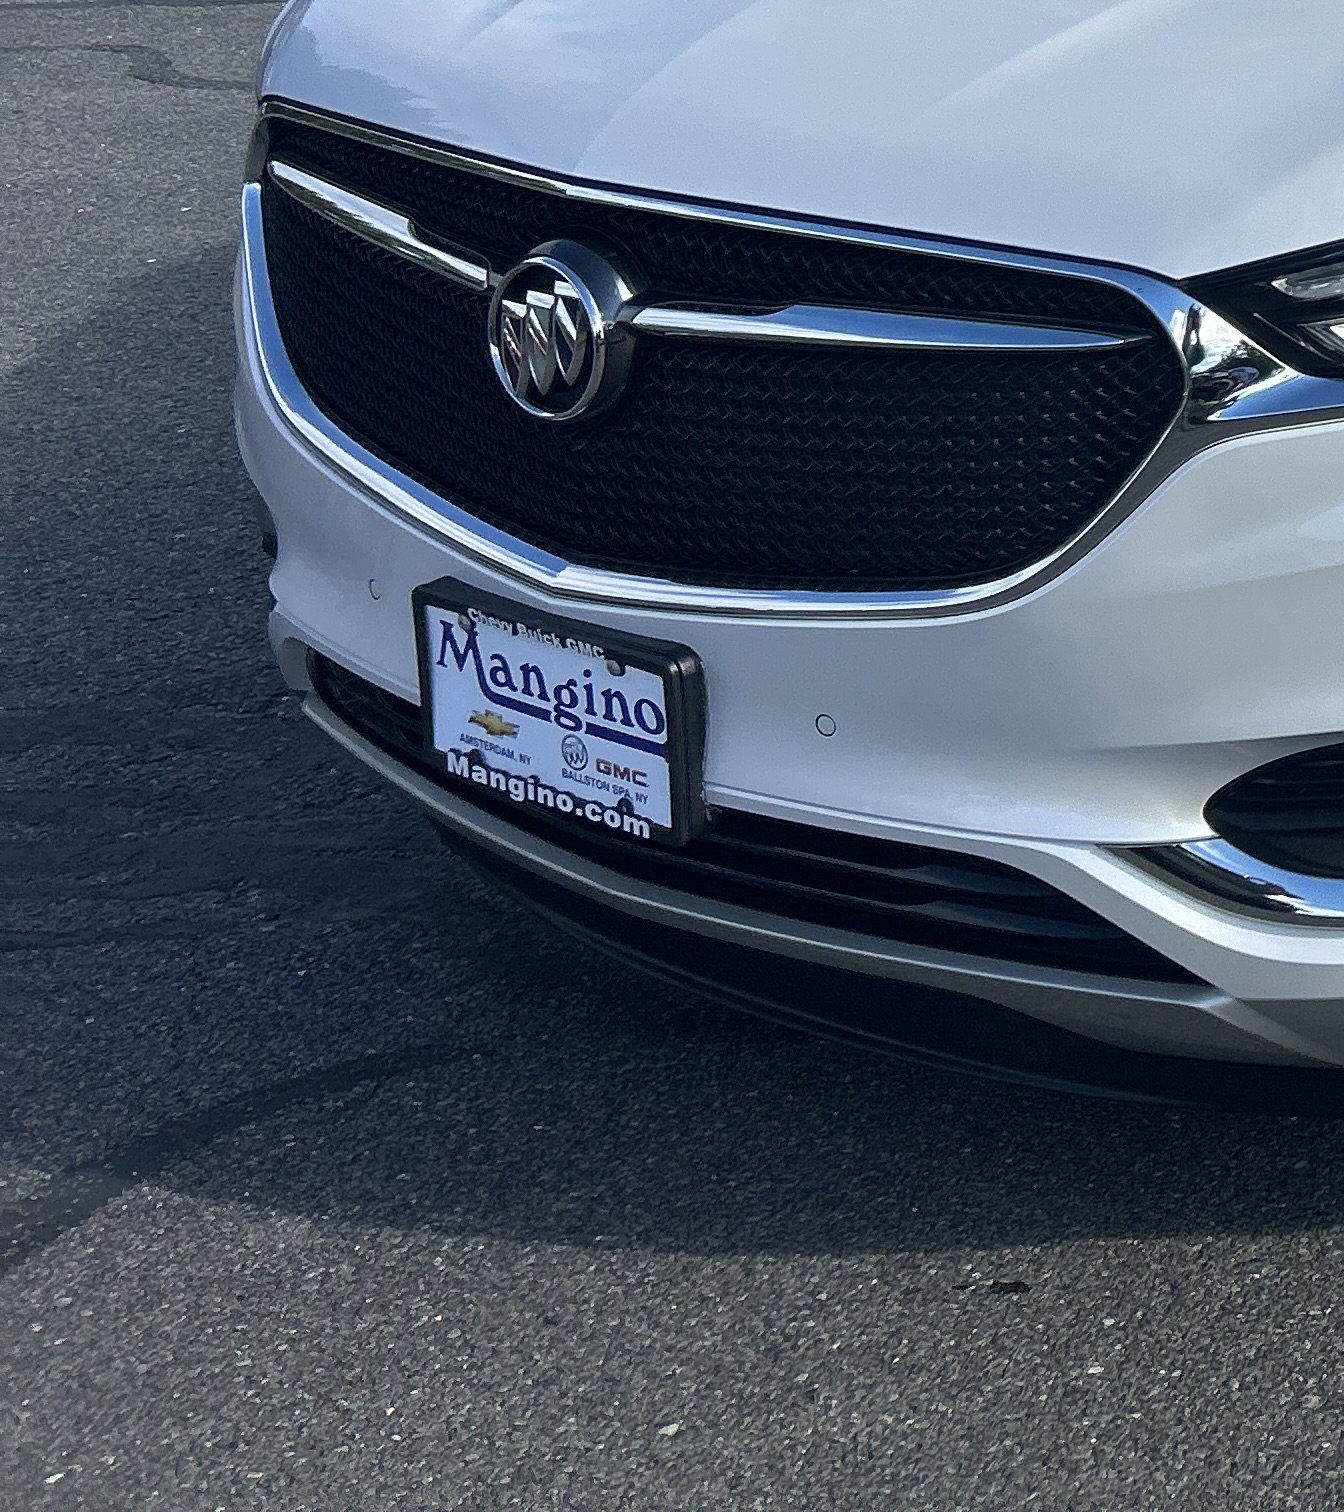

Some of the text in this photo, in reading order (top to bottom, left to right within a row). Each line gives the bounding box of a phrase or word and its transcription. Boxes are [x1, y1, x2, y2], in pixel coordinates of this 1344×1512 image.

[467, 607, 606, 660] Chevy Buick GMC
[436, 618, 667, 738] Mangino
[519, 752, 533, 766] NY
[596, 758, 649, 788] GMC
[446, 750, 651, 840] Mangino.com
[561, 767, 611, 793] BALLSTON
[635, 792, 649, 805] NY
